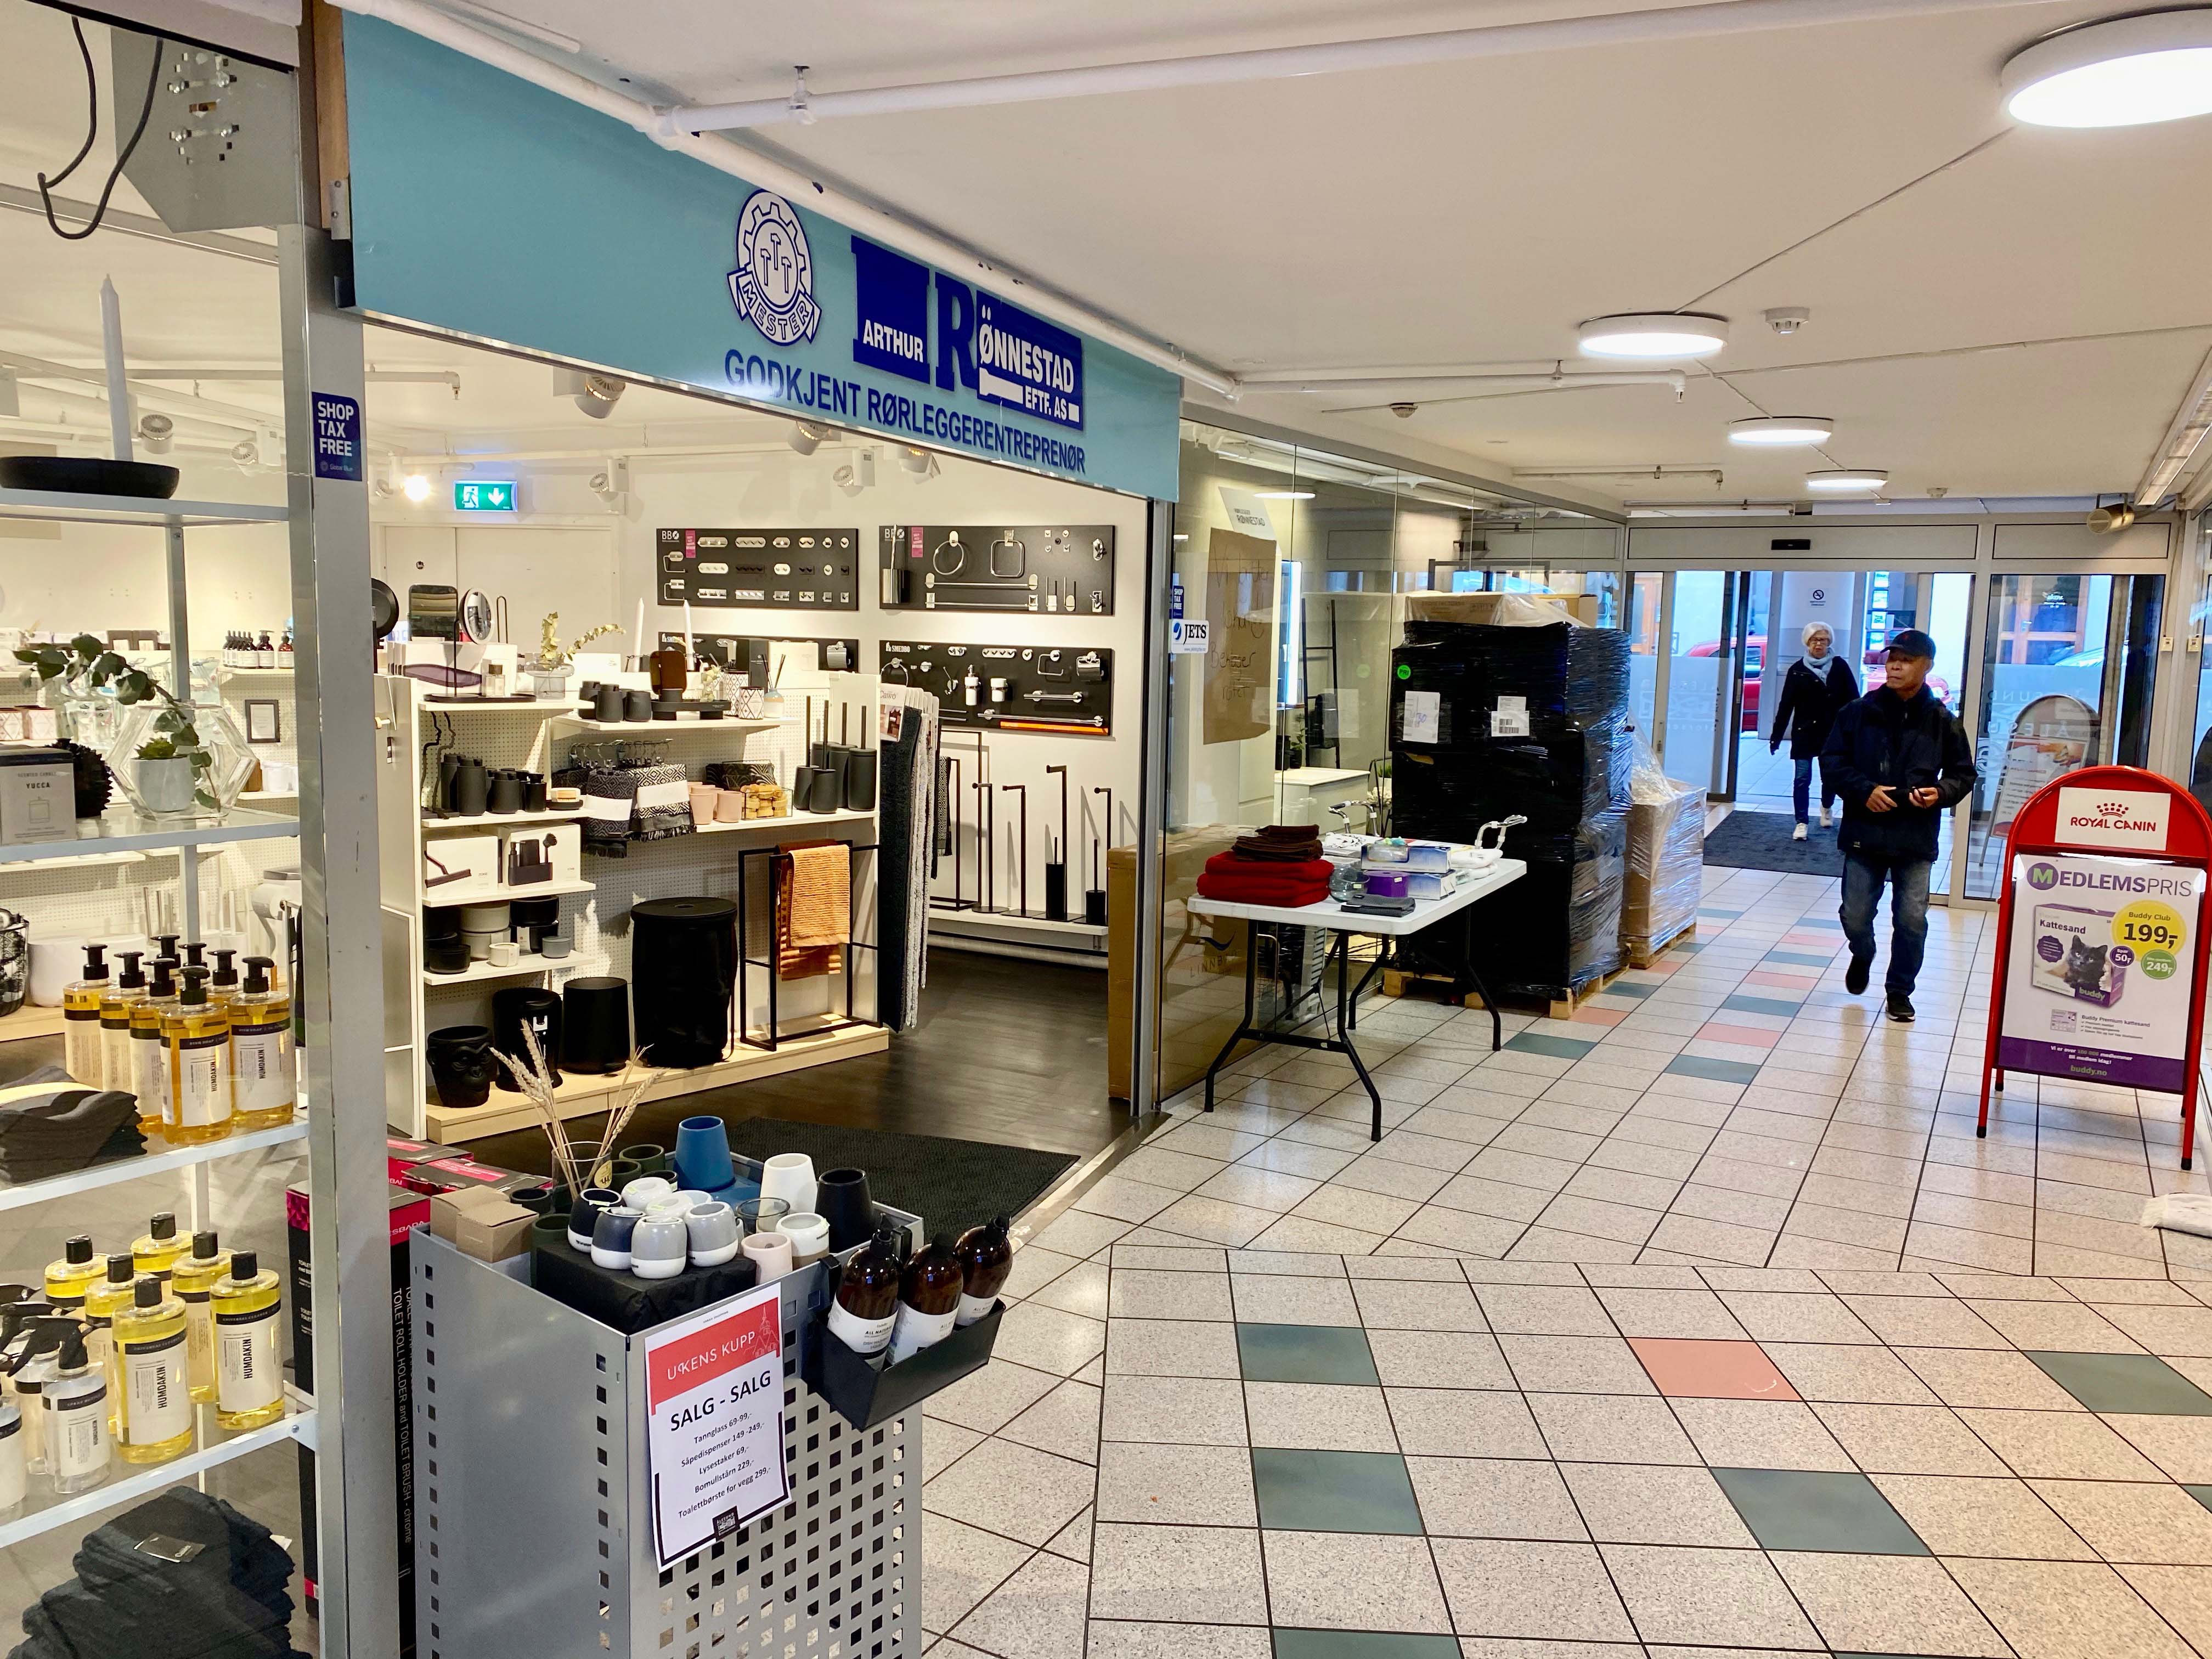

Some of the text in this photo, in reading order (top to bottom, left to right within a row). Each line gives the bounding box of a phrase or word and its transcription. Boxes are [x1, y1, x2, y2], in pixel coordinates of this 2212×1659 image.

[742, 280, 809, 340] MESTER
[863, 319, 924, 363] ARTHUR
[318, 401, 354, 421] SHOP
[725, 348, 1086, 474] GODKJENT RØRLEGGERENTREPRENØR
[1025, 385, 1067, 421] EFTF. AS
[318, 420, 345, 438] TAX
[319, 438, 352, 457] FREE
[1183, 624, 1206, 645] JETS
[2070, 817, 2156, 832] ROYAL CANIN
[2033, 868, 2192, 896] MEDLEMSPRIS
[2040, 919, 2086, 934] Kattesand
[2129, 912, 2152, 921] Buddy
[2124, 923, 2178, 949] 199,-
[2079, 987, 2105, 1001] buddy
[2099, 1017, 2123, 1025] Premium
[2070, 1065, 2107, 1076] buddy.no
[2100, 1052, 2133, 1061] medlemmer
[393, 1288, 404, 1325] TOILET
[242, 1338, 252, 1379] HUMDAKIN
[396, 1328, 405, 1358] ROLL
[667, 1331, 757, 1381] UKENS KUPP
[156, 1366, 167, 1409] HUMDAKIN
[397, 1358, 407, 1403] HOLDER
[670, 1397, 714, 1431] SALG
[730, 1370, 771, 1404] SALG
[399, 1423, 410, 1460] TOILET
[681, 1438, 730, 1468] Såpedispenser
[732, 1430, 744, 1442] 149
[694, 1424, 727, 1444] Tannglass
[695, 1459, 755, 1493] Bomullstårn 229,-
[699, 1446, 749, 1475] Lysestaker 69,-
[402, 1462, 411, 1501] BRUSH
[678, 1466, 771, 1519] Toalettbørste for vegg 299,-
[404, 1508, 412, 1544] chrome
